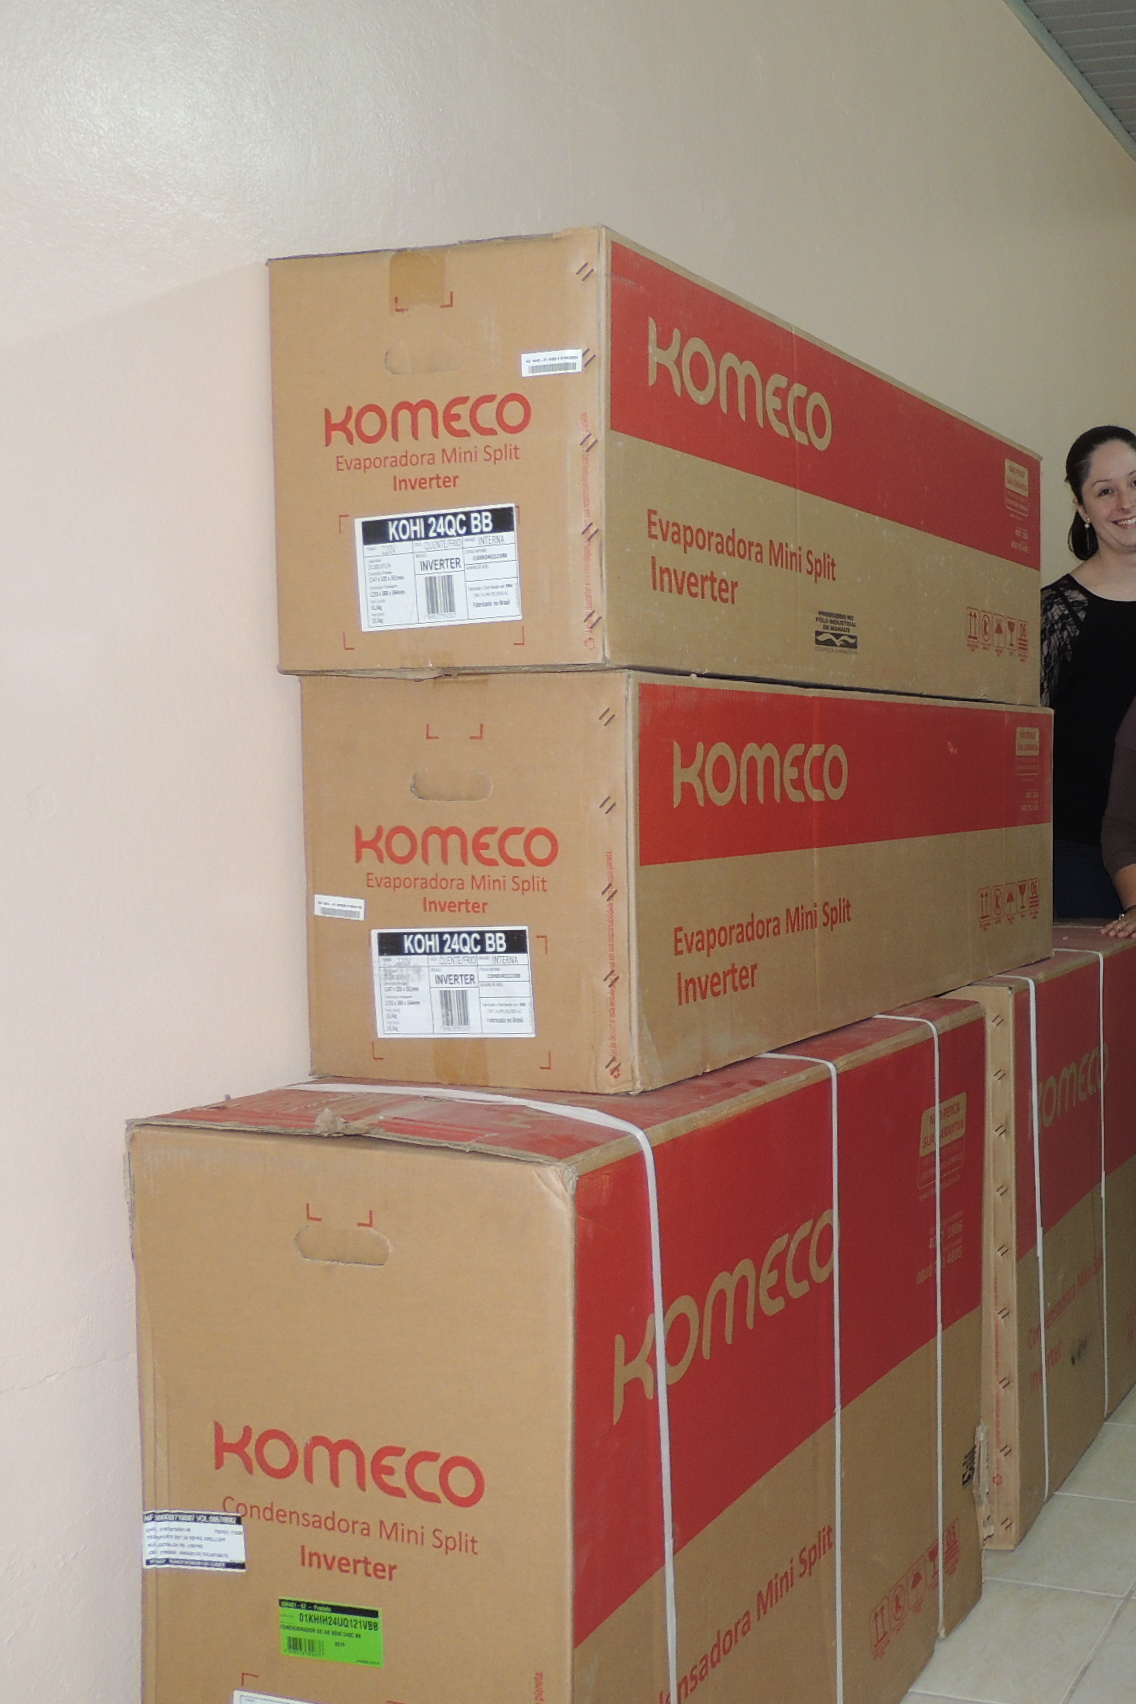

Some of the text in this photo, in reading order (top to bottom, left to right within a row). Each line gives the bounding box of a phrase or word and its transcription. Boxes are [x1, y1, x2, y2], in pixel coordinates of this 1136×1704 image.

[648, 315, 833, 451] KOMECO
[324, 392, 532, 447] KOMECO
[336, 444, 520, 474] Evaporadora Mini Split
[393, 474, 459, 491] Inverter
[388, 512, 493, 541] KOHI 24QC BB
[478, 535, 505, 544] INTERNA
[647, 508, 837, 582] Evaporadora Mini Split
[420, 557, 462, 571] INVERTER
[650, 556, 739, 604] Inverter
[829, 619, 857, 627] INDUSTRIAL
[673, 740, 849, 809] KOMECO
[354, 824, 559, 867] KOMECO
[366, 873, 547, 894] Evaporadora Mini Split
[423, 897, 488, 913] Inverter
[404, 932, 507, 953] KOHI 24QC BB
[673, 897, 851, 957] Evaporadora Mini Split
[492, 955, 518, 964] INTERNA
[435, 974, 475, 985] INVERTER
[677, 960, 758, 1006] Inverter
[214, 1420, 485, 1508] KOMECO
[222, 1495, 479, 1556] Condensadora Mini Split
[300, 1545, 397, 1581] Inverter
[659, 1525, 834, 1704] nsadora Mini Split
